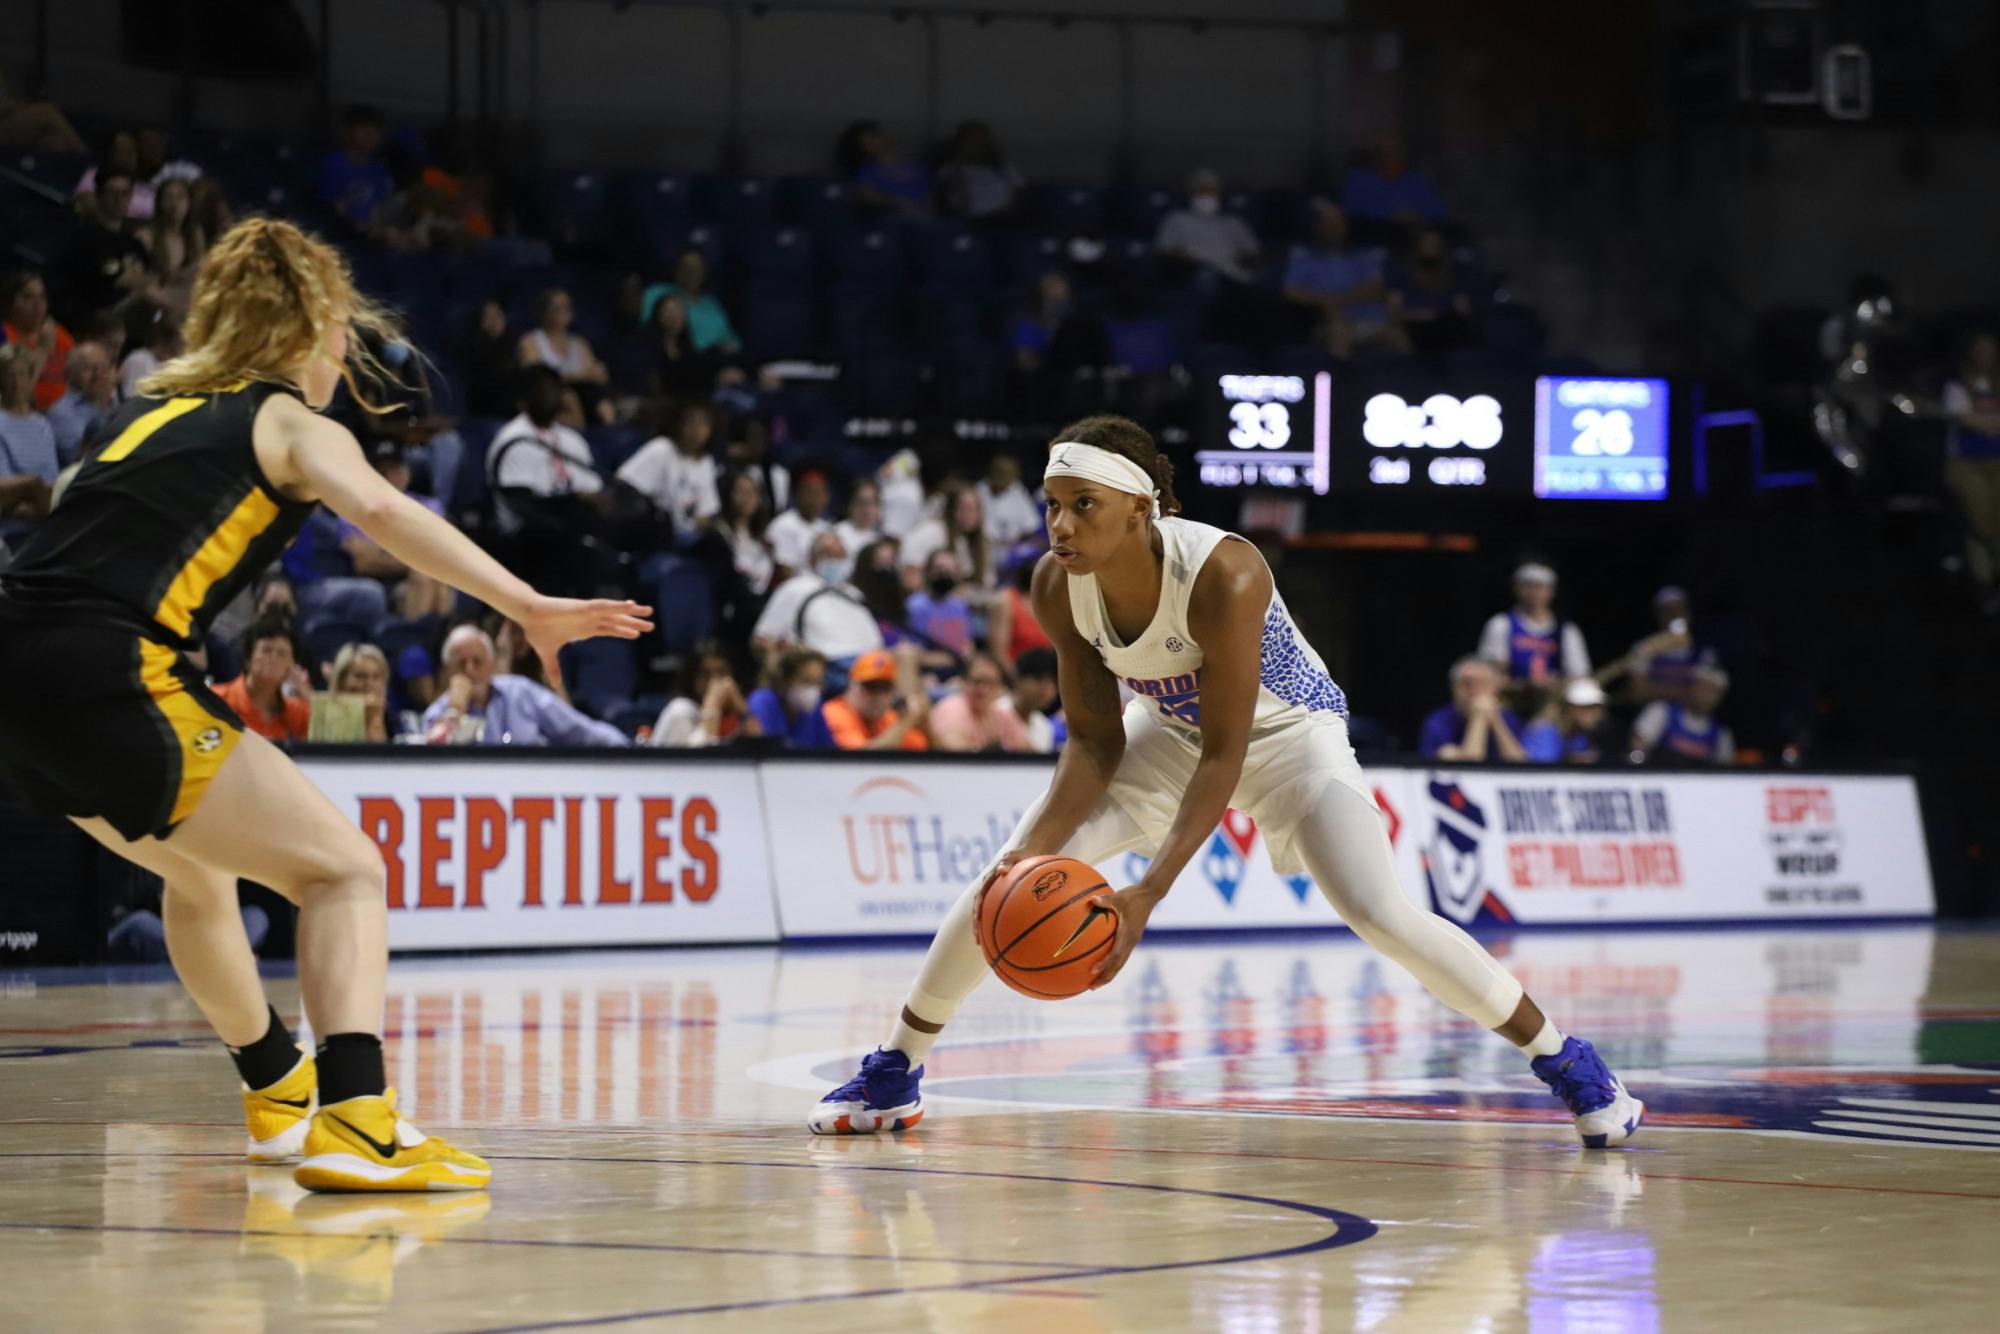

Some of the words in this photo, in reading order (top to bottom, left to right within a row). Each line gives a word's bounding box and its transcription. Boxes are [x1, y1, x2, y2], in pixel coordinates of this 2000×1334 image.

[97, 398, 208, 461] 1
[1228, 402, 1291, 449] 33
[1116, 669, 1201, 697] ORID
[356, 794, 719, 910] REPTILES
[0, 931, 38, 951] rtgage
